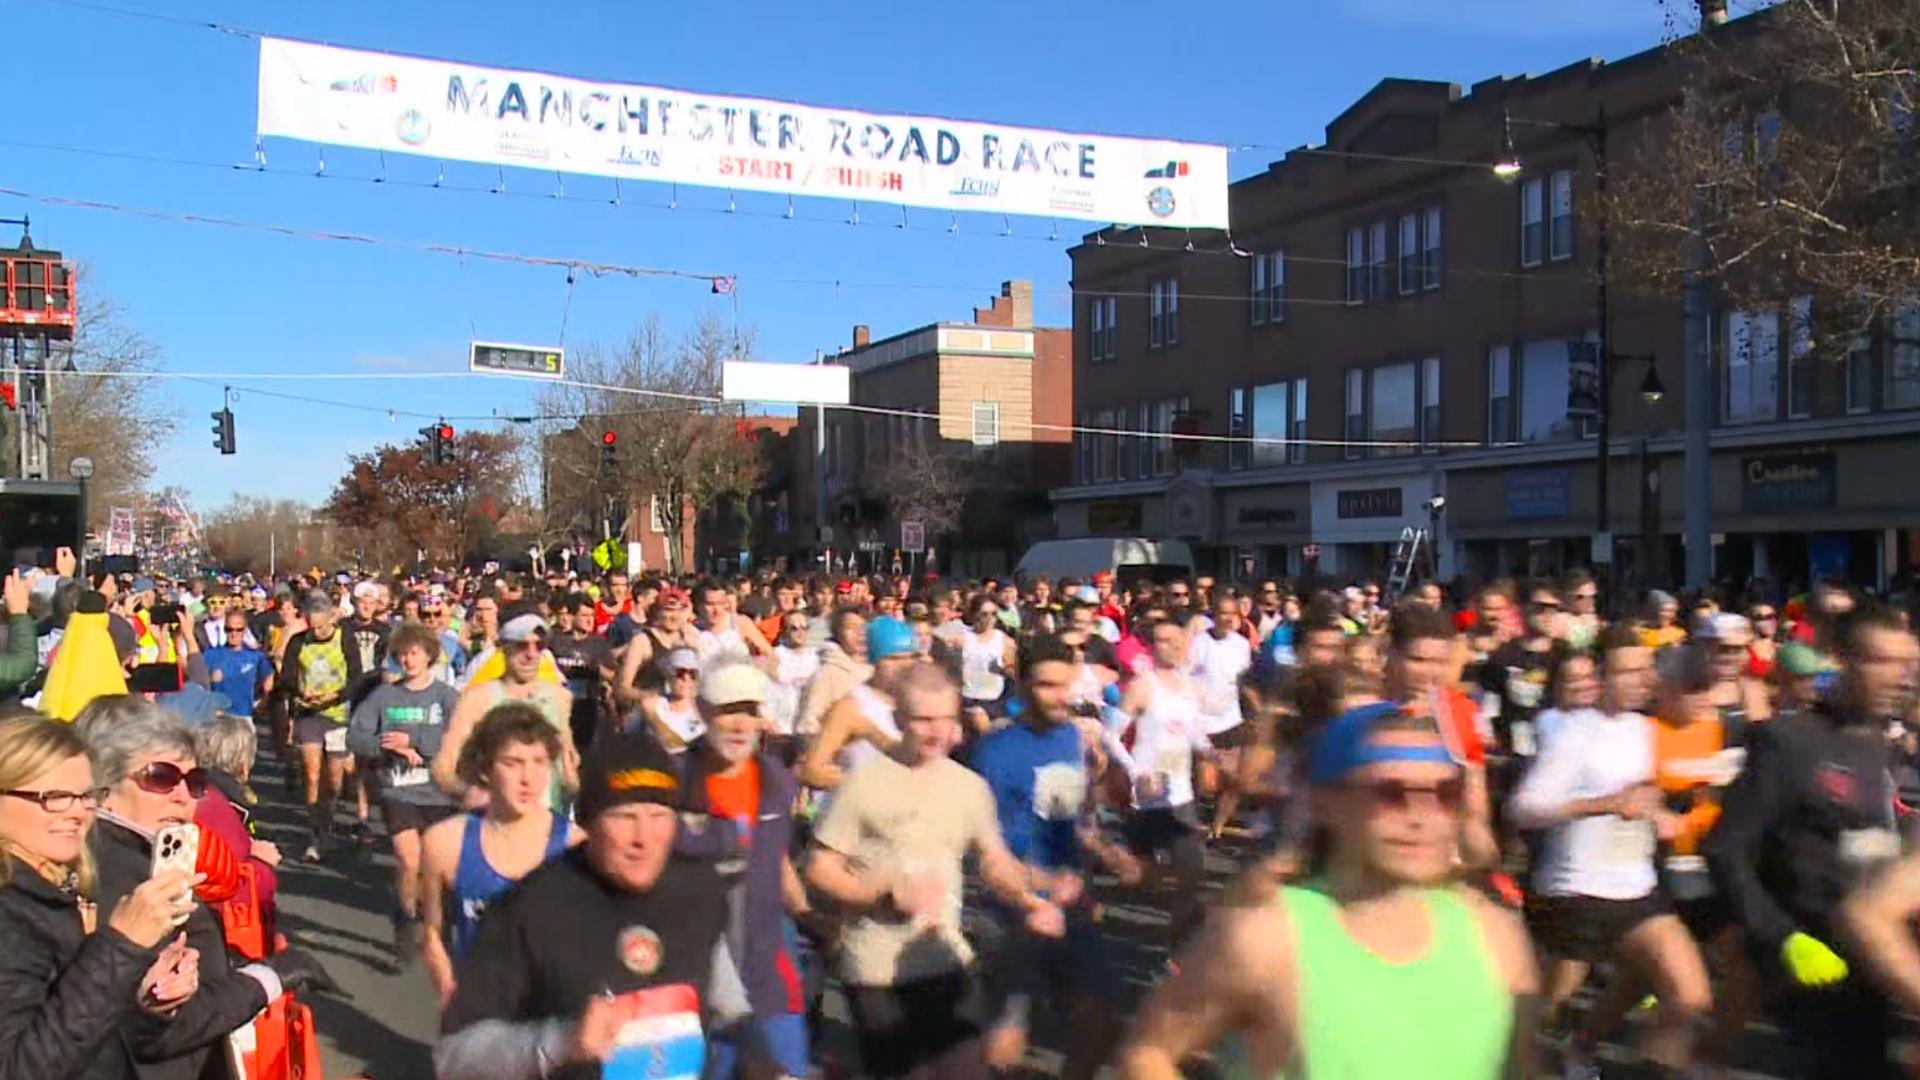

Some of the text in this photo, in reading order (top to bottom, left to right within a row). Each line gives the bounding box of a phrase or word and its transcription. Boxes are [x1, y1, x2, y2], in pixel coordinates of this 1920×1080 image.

[447, 75, 804, 152] MANCHESTER
[828, 118, 960, 166] ROAD
[982, 134, 1095, 179] RACE
[719, 154, 793, 181] START
[827, 166, 903, 192] FINISH
